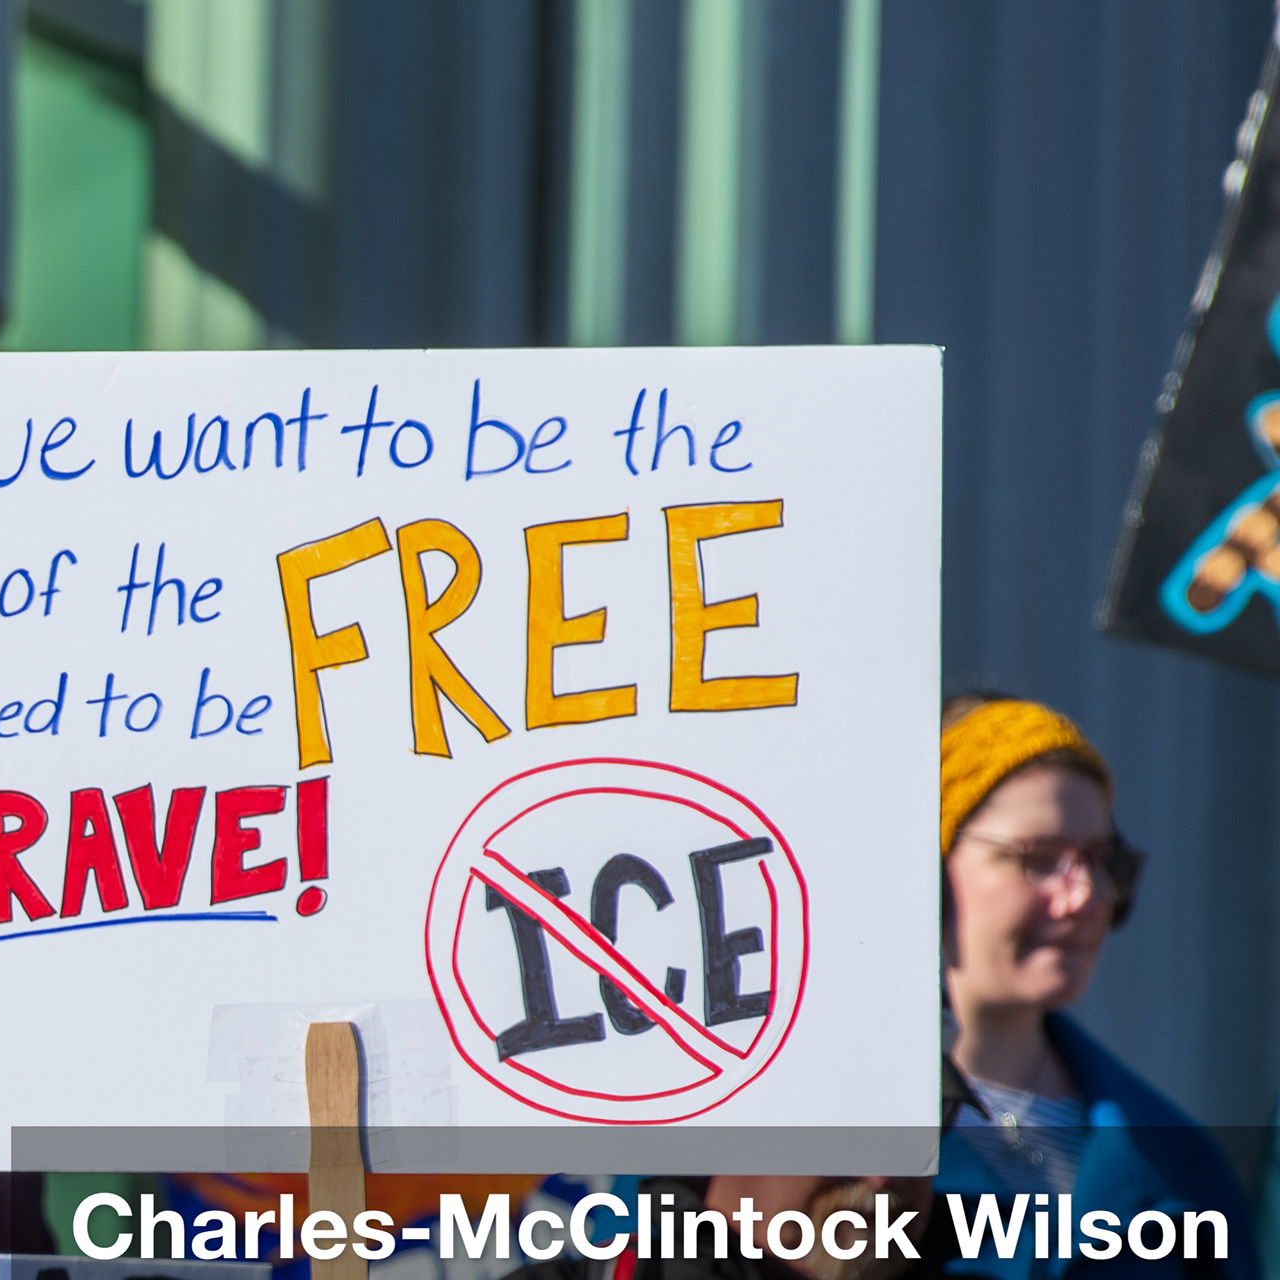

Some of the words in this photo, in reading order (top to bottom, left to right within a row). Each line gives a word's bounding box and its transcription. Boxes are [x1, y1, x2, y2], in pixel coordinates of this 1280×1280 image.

[122, 384, 329, 481] want
[338, 382, 434, 479] to
[462, 378, 575, 482] be
[613, 386, 754, 478] the
[95, 671, 160, 738] to
[190, 667, 273, 741] be
[116, 541, 224, 637] the
[276, 498, 801, 771] FREE
[483, 836, 776, 1064] ICE
